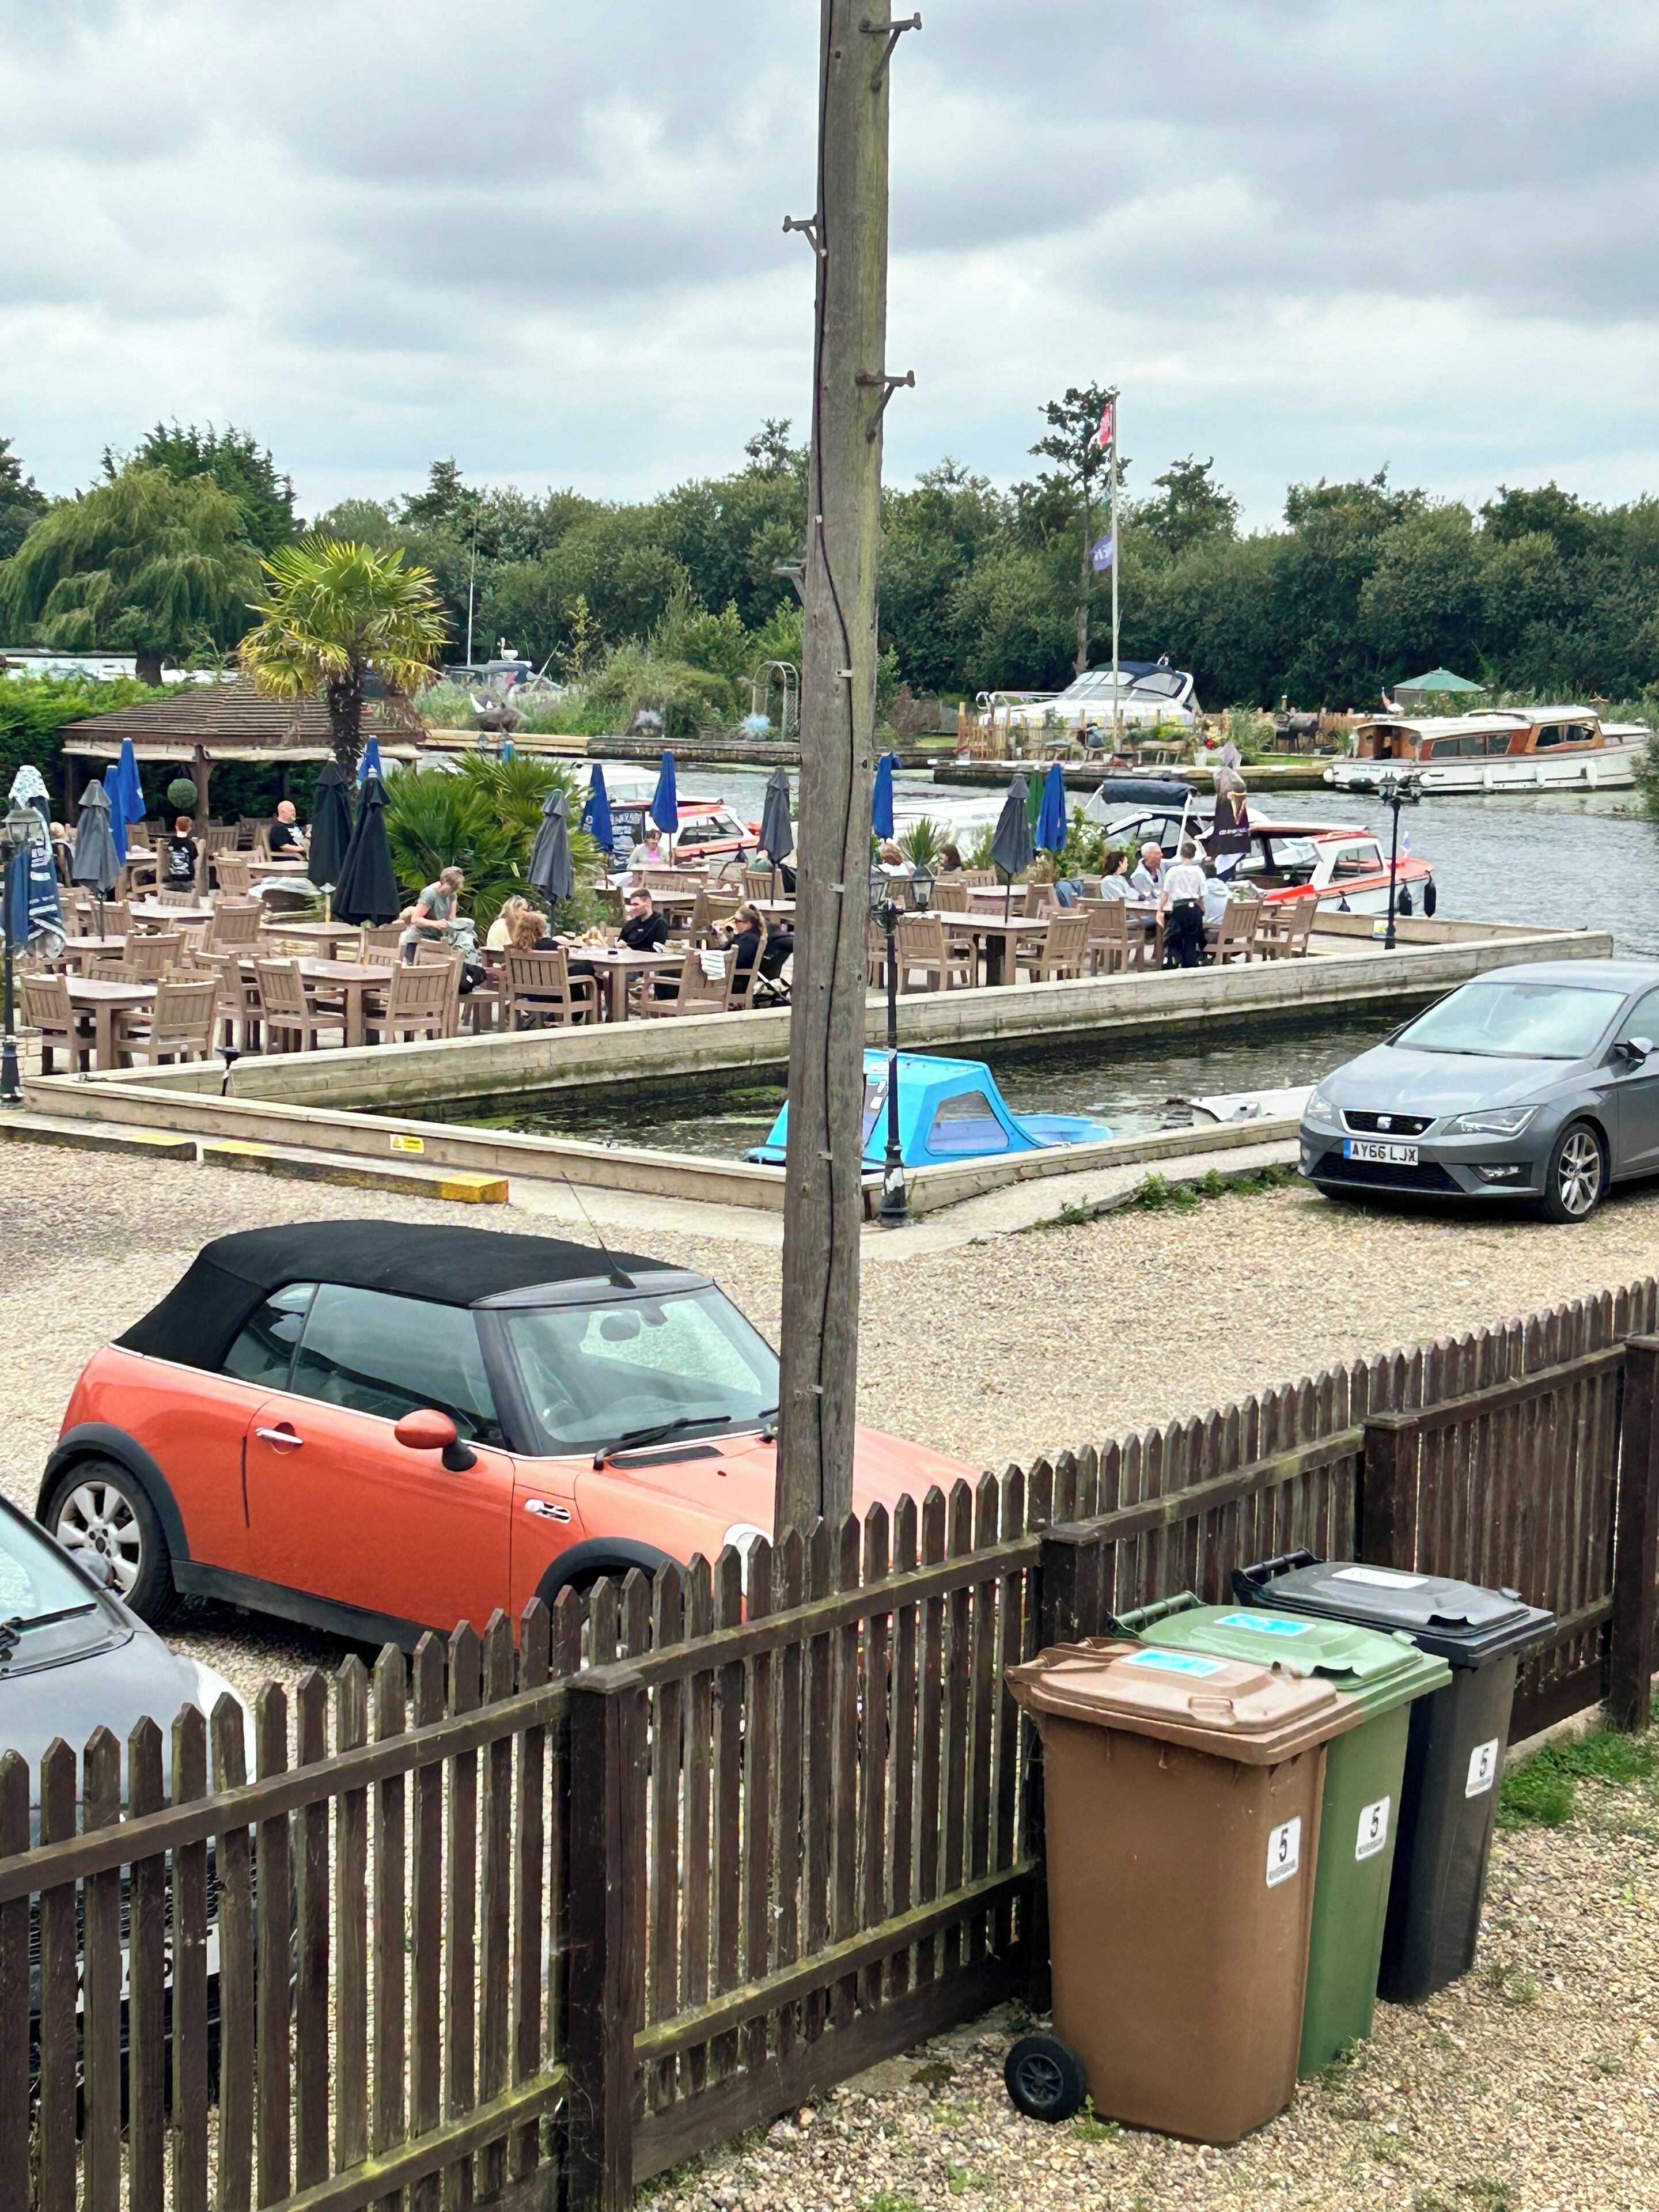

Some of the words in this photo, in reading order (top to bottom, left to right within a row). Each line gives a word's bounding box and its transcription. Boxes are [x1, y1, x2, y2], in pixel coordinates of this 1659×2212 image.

[1352, 1143, 1386, 1160] AY66
[1390, 1146, 1416, 1162] LJX
[1479, 1747, 1489, 1778] 5
[1370, 1805, 1381, 1838] 5
[1279, 1827, 1289, 1862] 5
